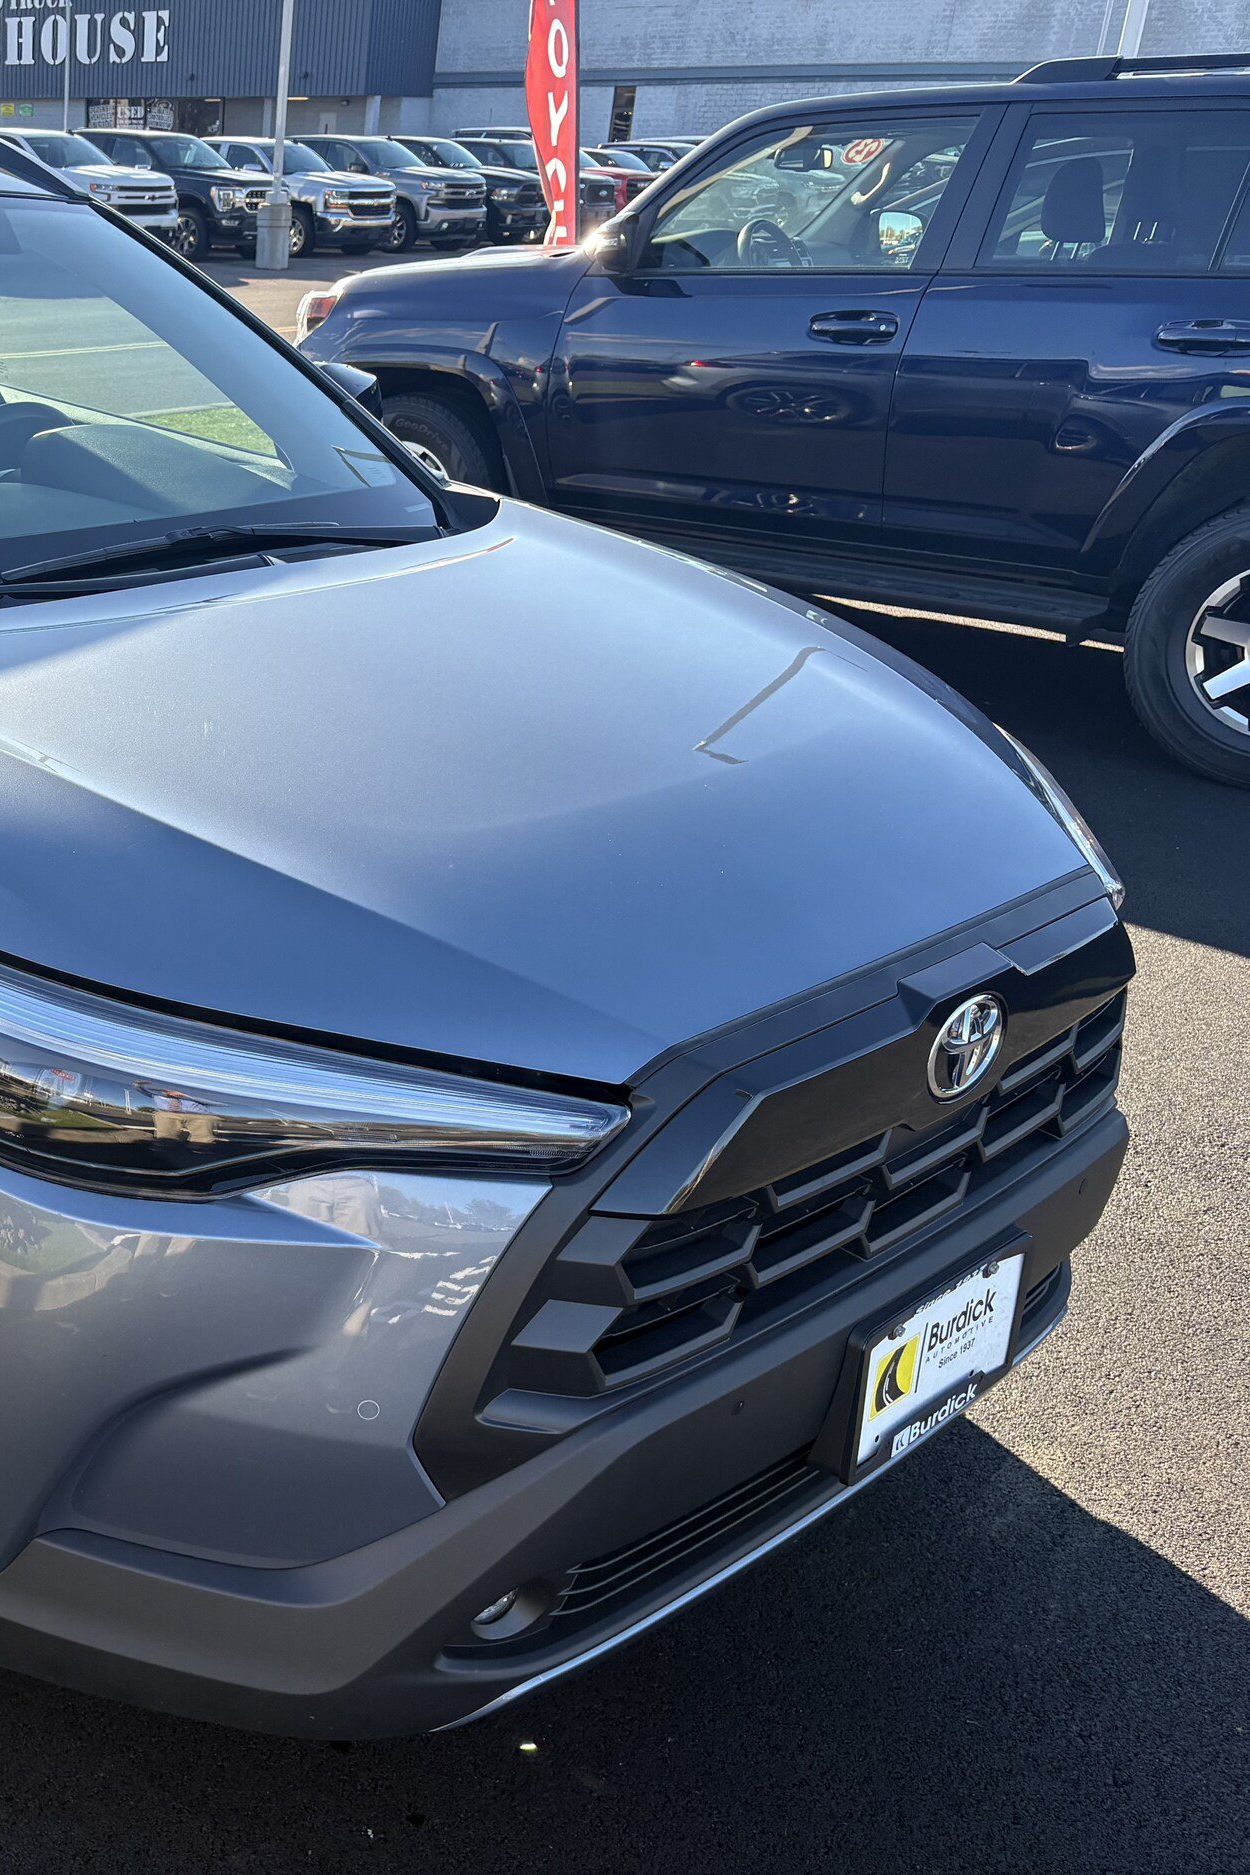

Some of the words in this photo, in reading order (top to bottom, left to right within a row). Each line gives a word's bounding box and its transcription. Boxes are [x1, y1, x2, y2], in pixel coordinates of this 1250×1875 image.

[116, 106, 145, 118] USED
[925, 1315, 994, 1364] AUTOMOTIVE
[928, 1287, 997, 1353] Burdick
[938, 1351, 958, 1369] Since
[959, 1337, 976, 1355] 1937
[909, 1383, 978, 1444] Burdick
